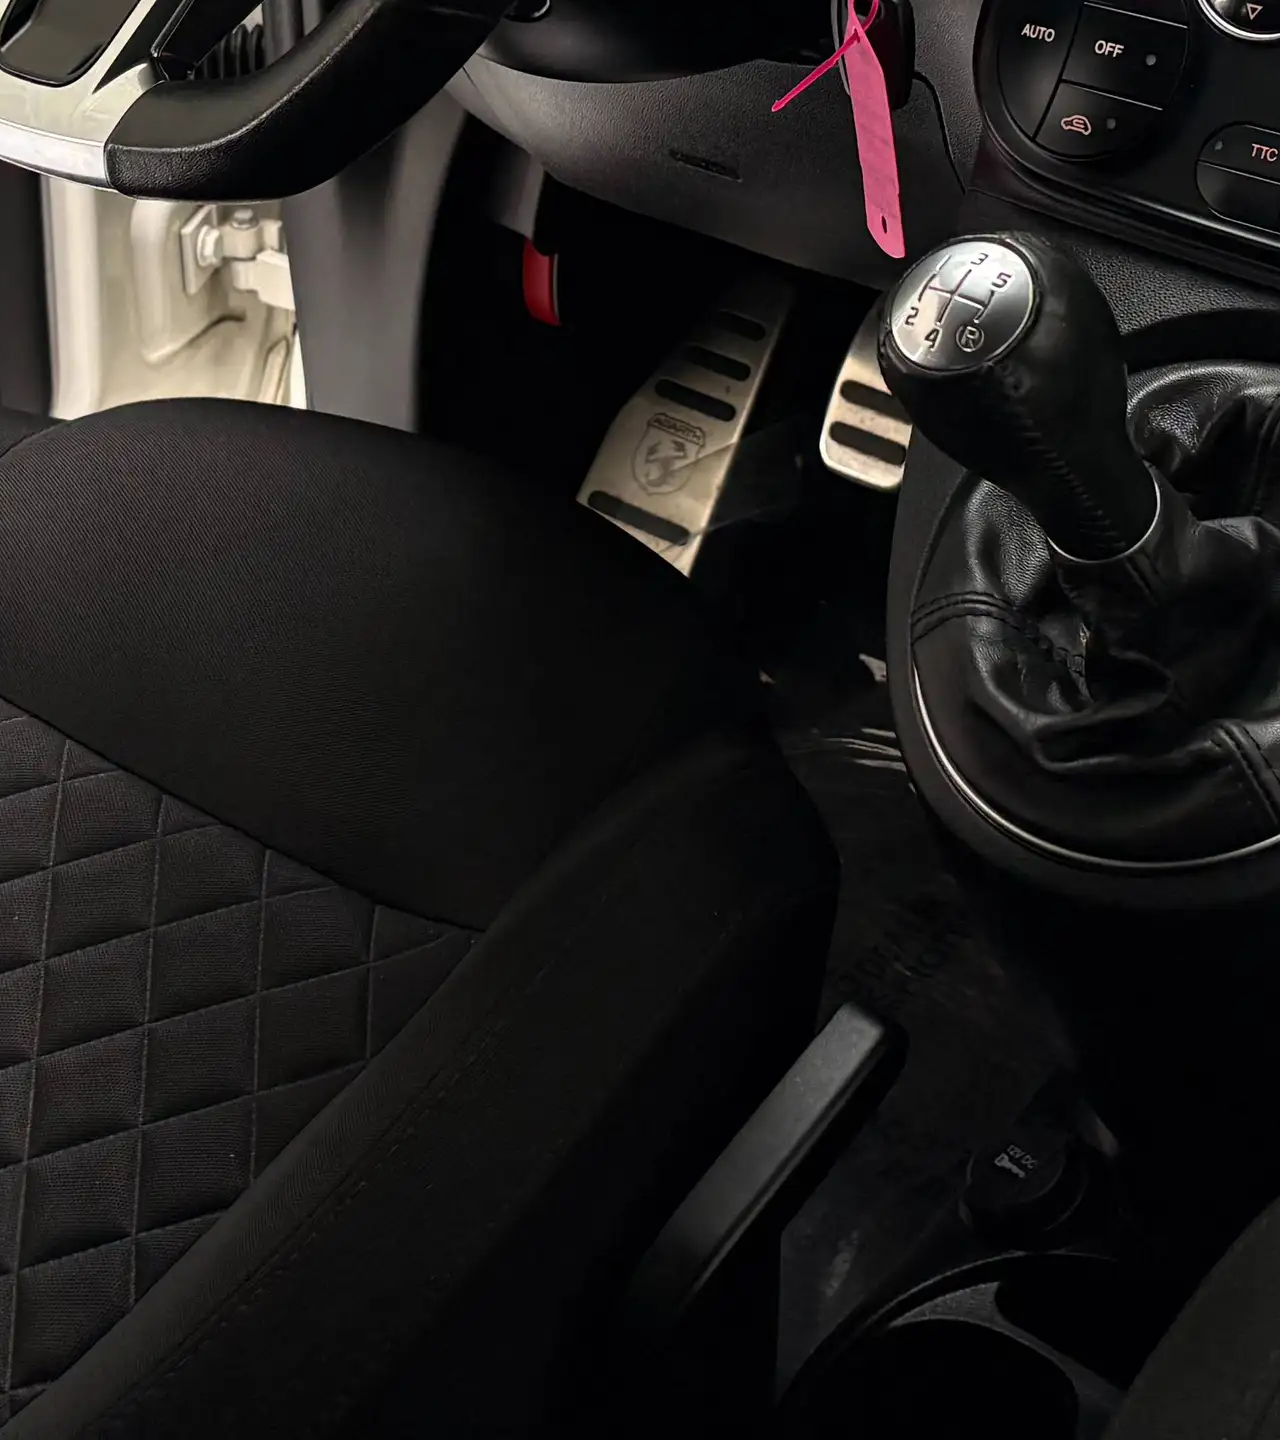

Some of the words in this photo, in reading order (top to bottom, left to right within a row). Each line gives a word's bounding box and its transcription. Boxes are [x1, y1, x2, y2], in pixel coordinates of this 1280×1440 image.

[1021, 22, 1056, 43] AUTO
[1094, 39, 1125, 58] OFF
[1251, 142, 1279, 162] TTC
[970, 252, 989, 266] 3
[991, 271, 1012, 289] 5
[904, 306, 920, 326] 2
[924, 328, 942, 351] 4
